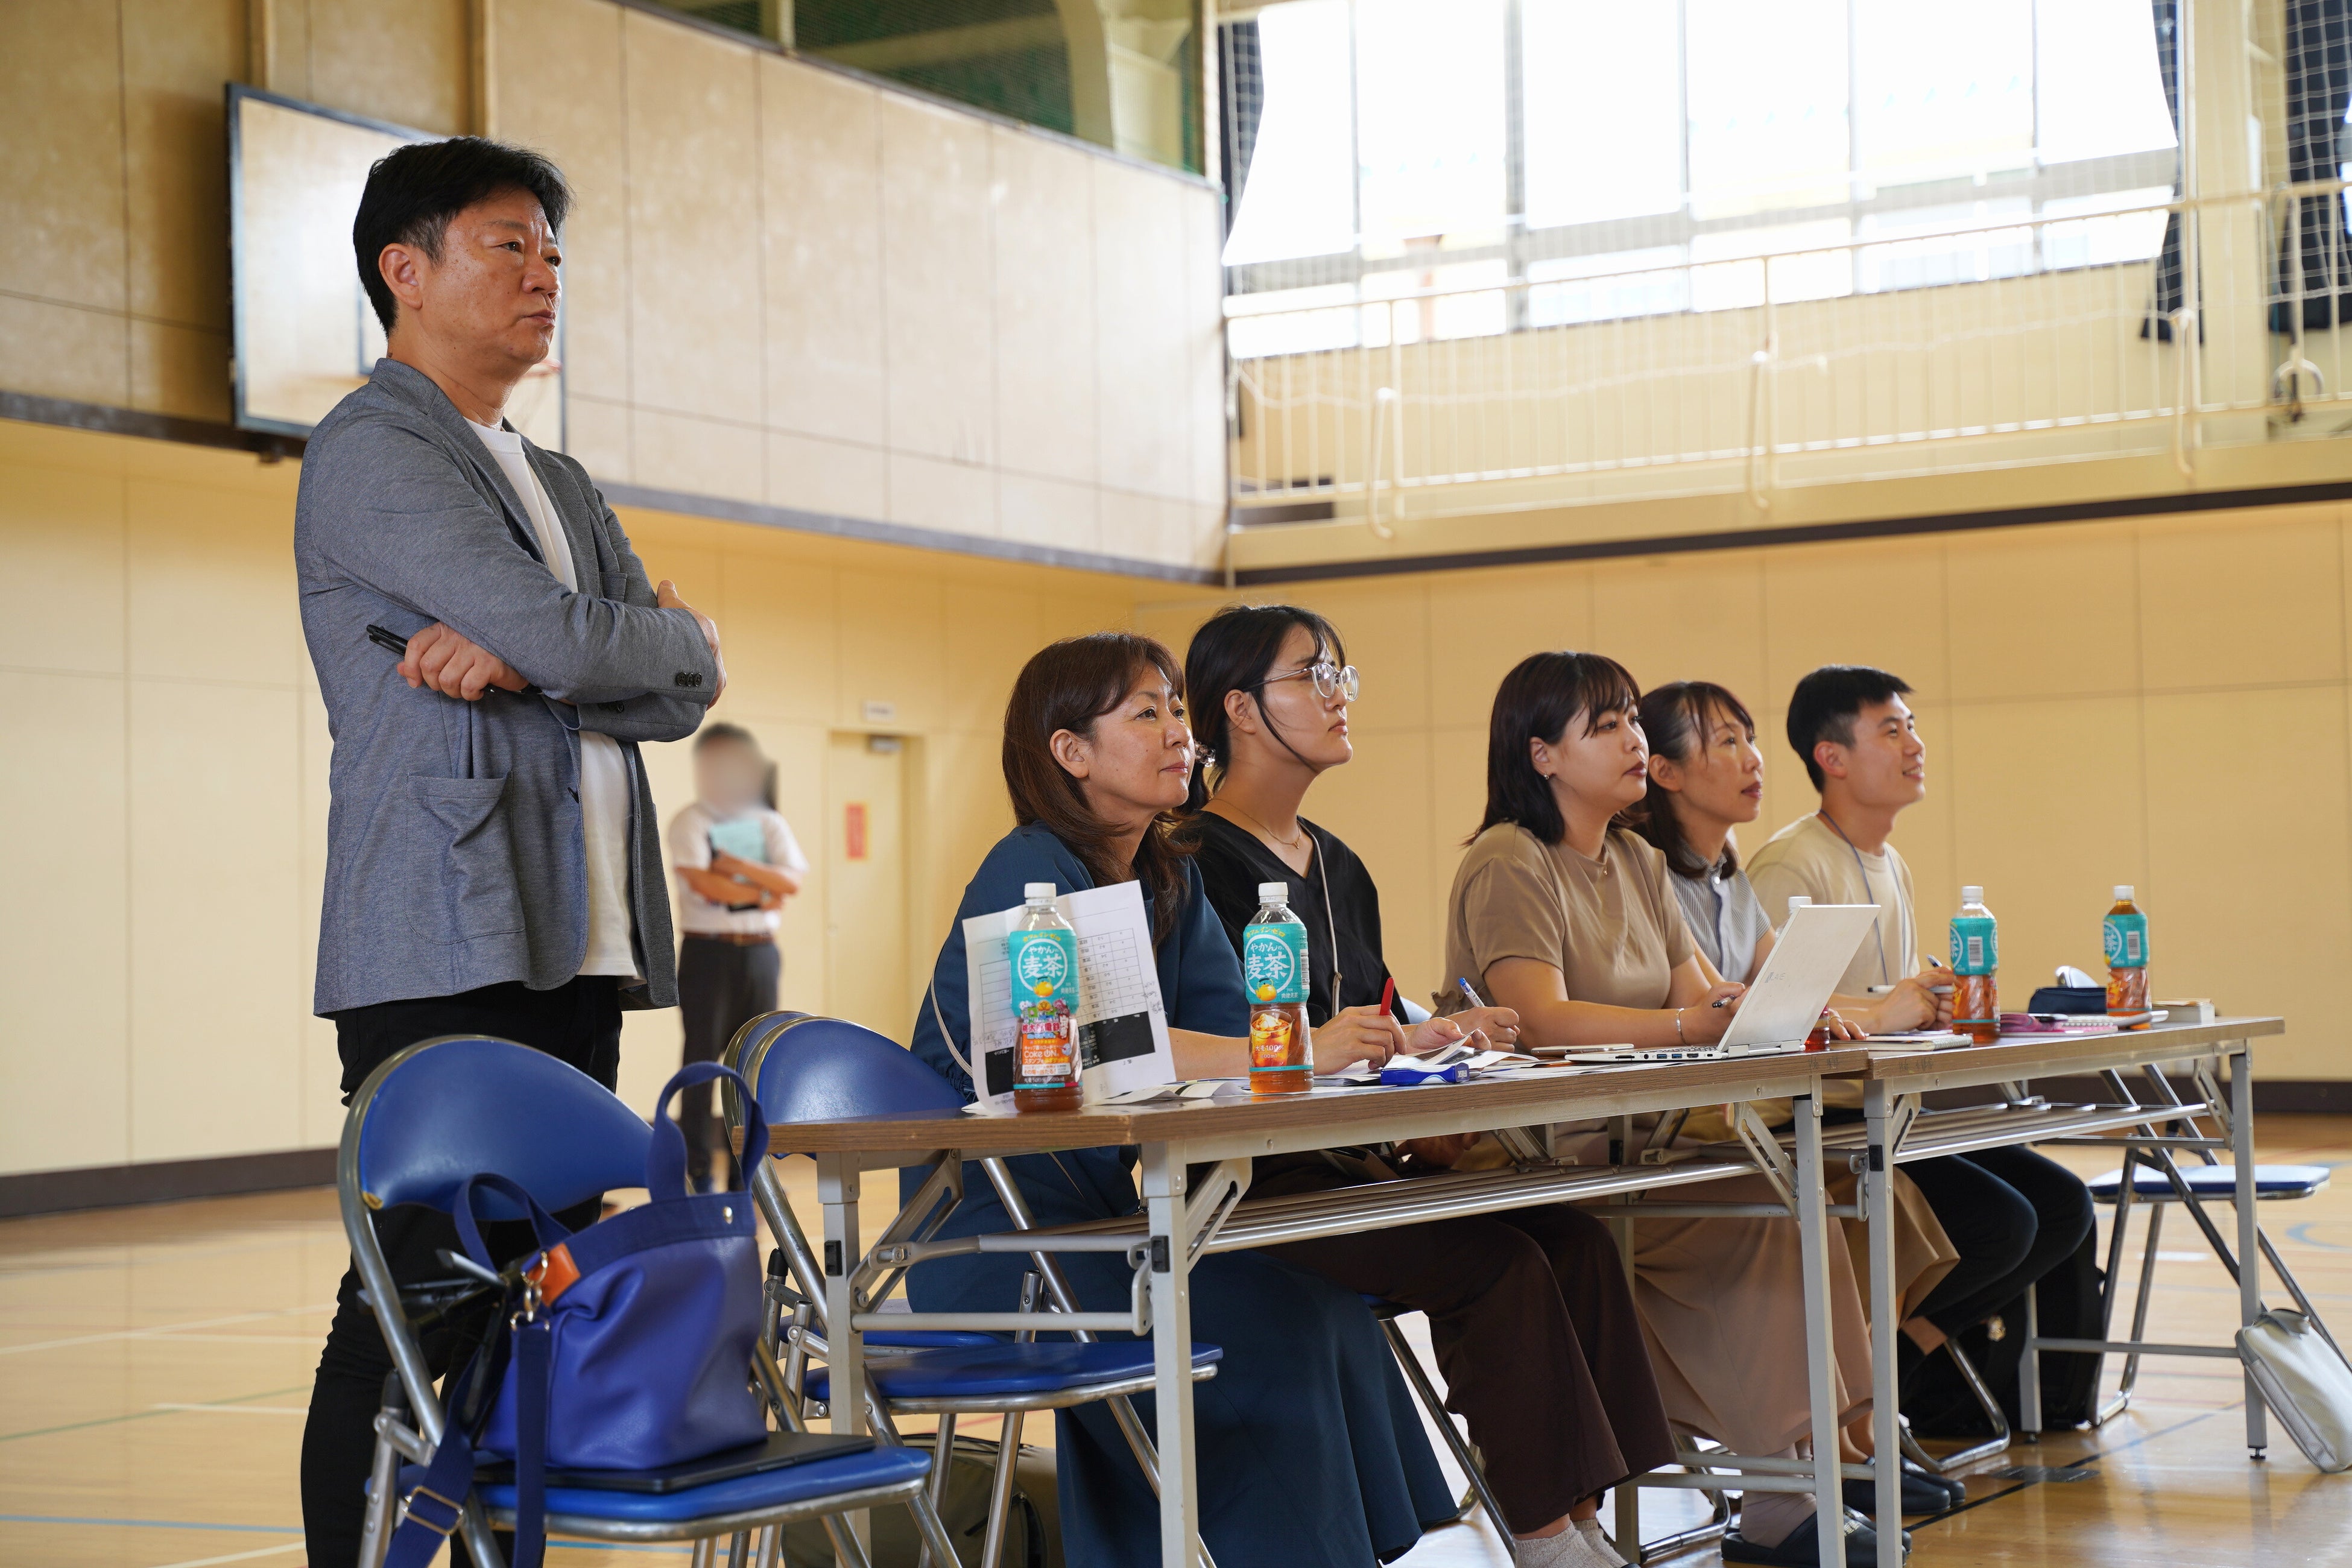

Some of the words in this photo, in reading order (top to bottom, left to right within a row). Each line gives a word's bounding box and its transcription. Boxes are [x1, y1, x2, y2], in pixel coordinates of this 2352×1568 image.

[1251, 942, 1285, 953] やかんの
[1022, 953, 1064, 978] 麦茶
[1247, 951, 1290, 980] 麦茶
[1024, 1050, 1043, 1058] Coke
